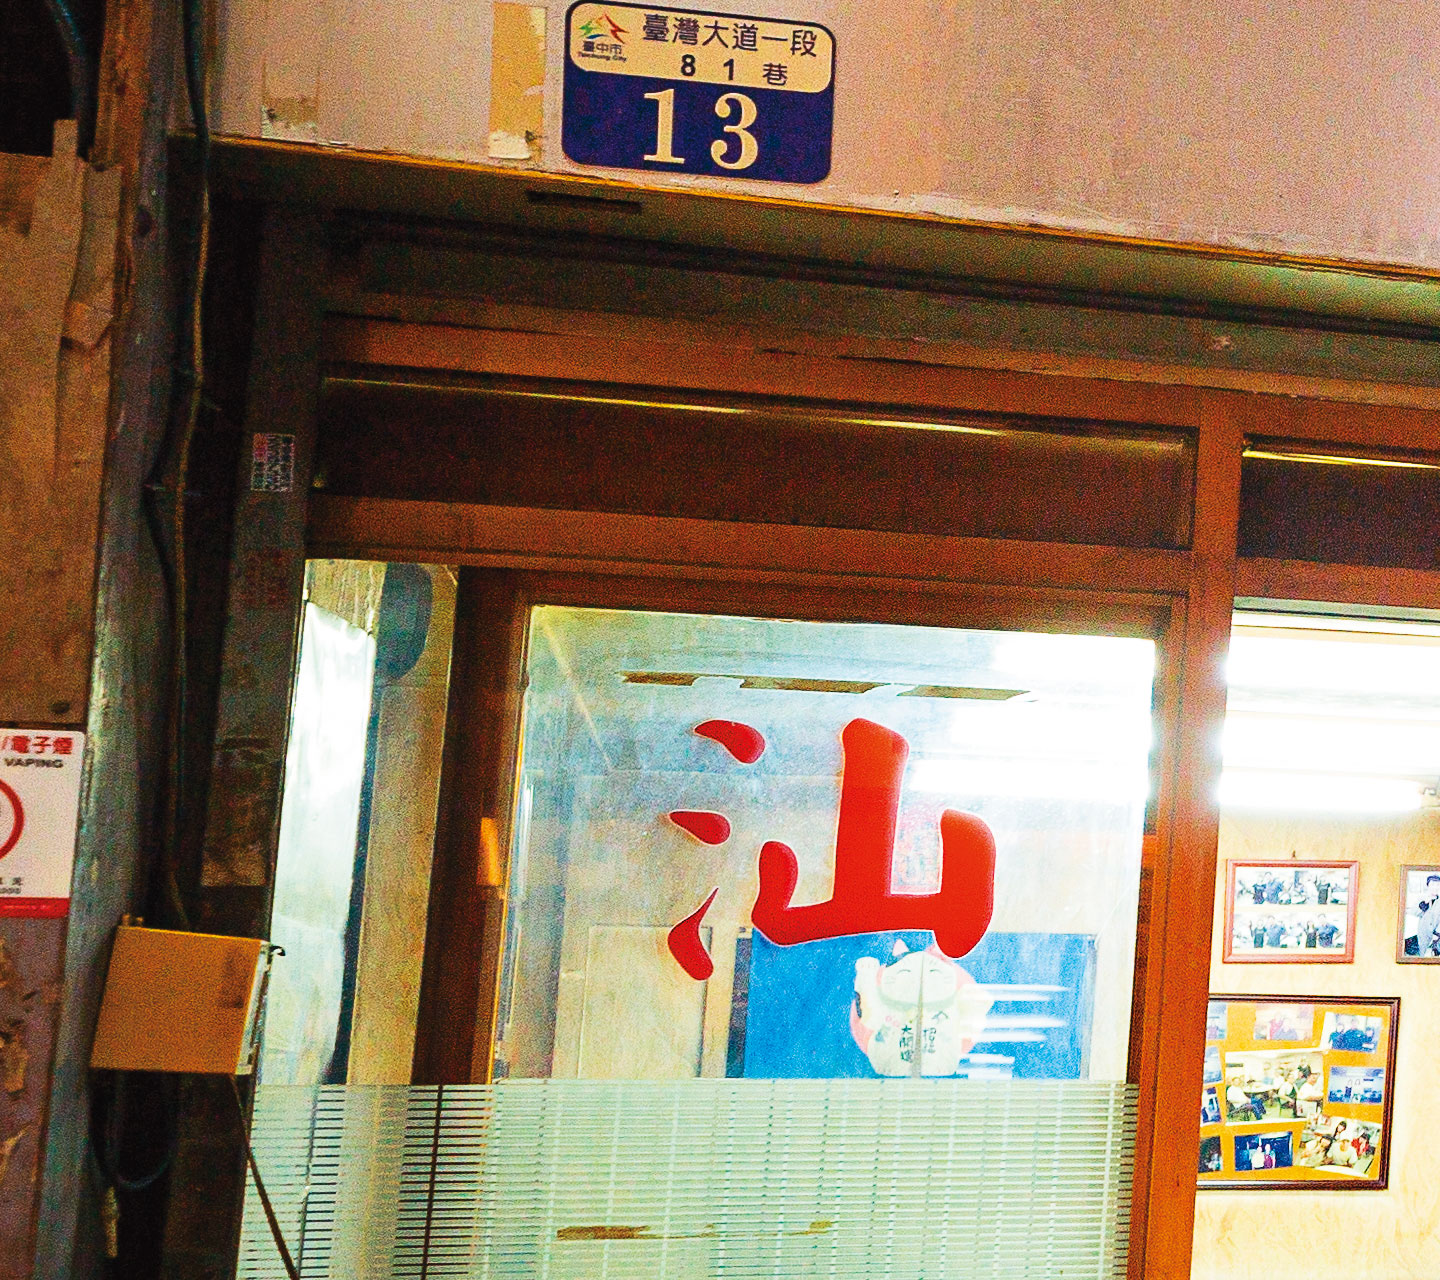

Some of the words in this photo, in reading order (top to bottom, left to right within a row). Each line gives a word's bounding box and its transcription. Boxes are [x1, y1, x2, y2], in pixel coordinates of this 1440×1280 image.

[642, 13, 818, 59] 臺灣大道一段
[643, 88, 760, 171] 13
[4, 758, 64, 769] VAPING
[667, 718, 997, 981] 汕
